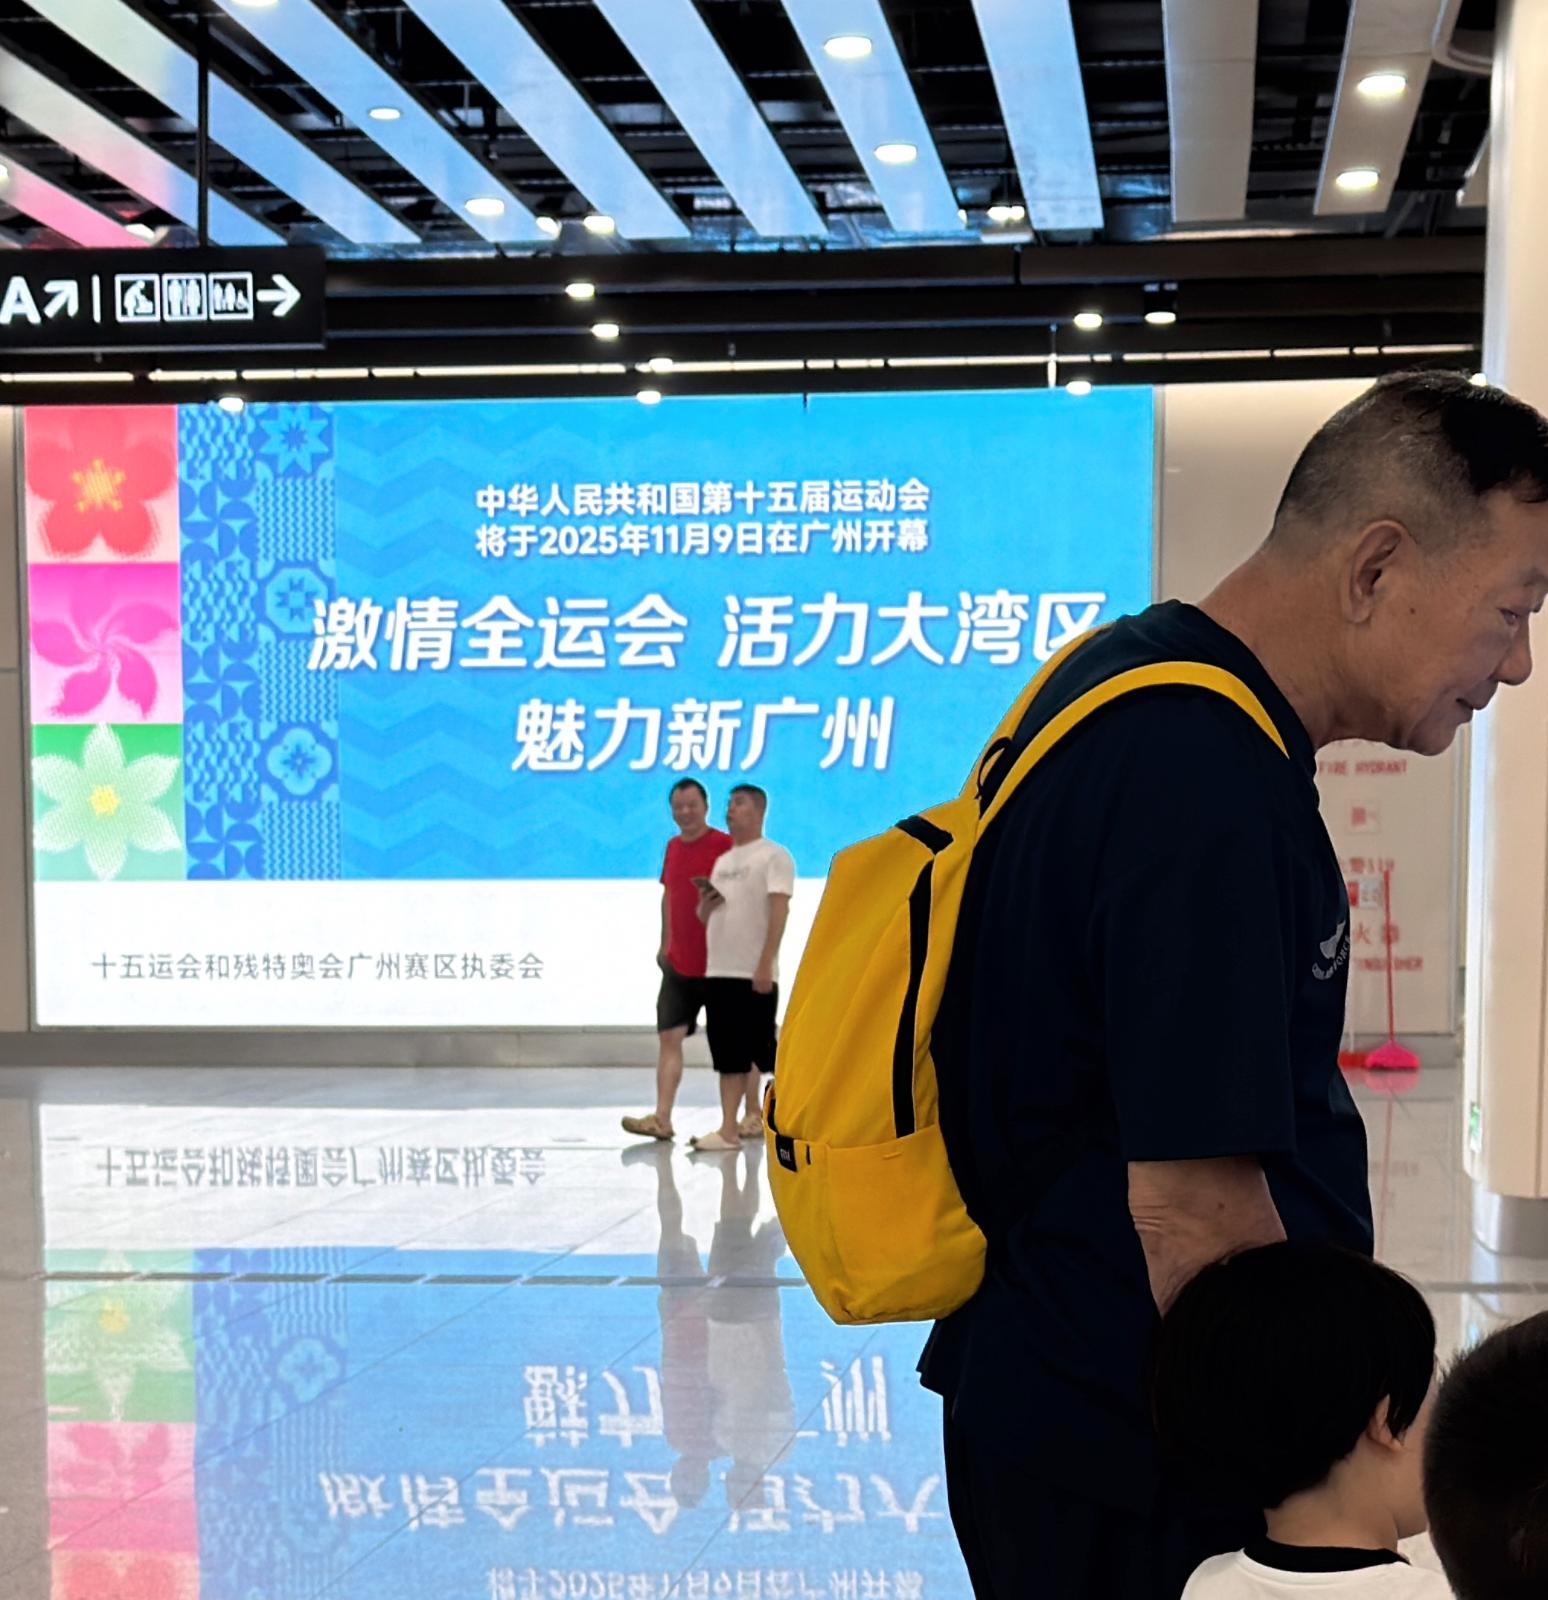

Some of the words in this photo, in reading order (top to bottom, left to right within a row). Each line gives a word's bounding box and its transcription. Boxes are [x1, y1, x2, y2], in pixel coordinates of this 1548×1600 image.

[0, 276, 41, 324] A
[476, 478, 931, 517] 中华人民共和国第十五届运动会
[476, 519, 929, 558] 将于2025年11月9日在广州开幕
[307, 595, 689, 672] 激情全运会
[717, 591, 1107, 669] 活力大湾区
[512, 697, 895, 773] 魅力新广州
[92, 953, 544, 981] 十五运会和残特奥会广州赛区执委会
